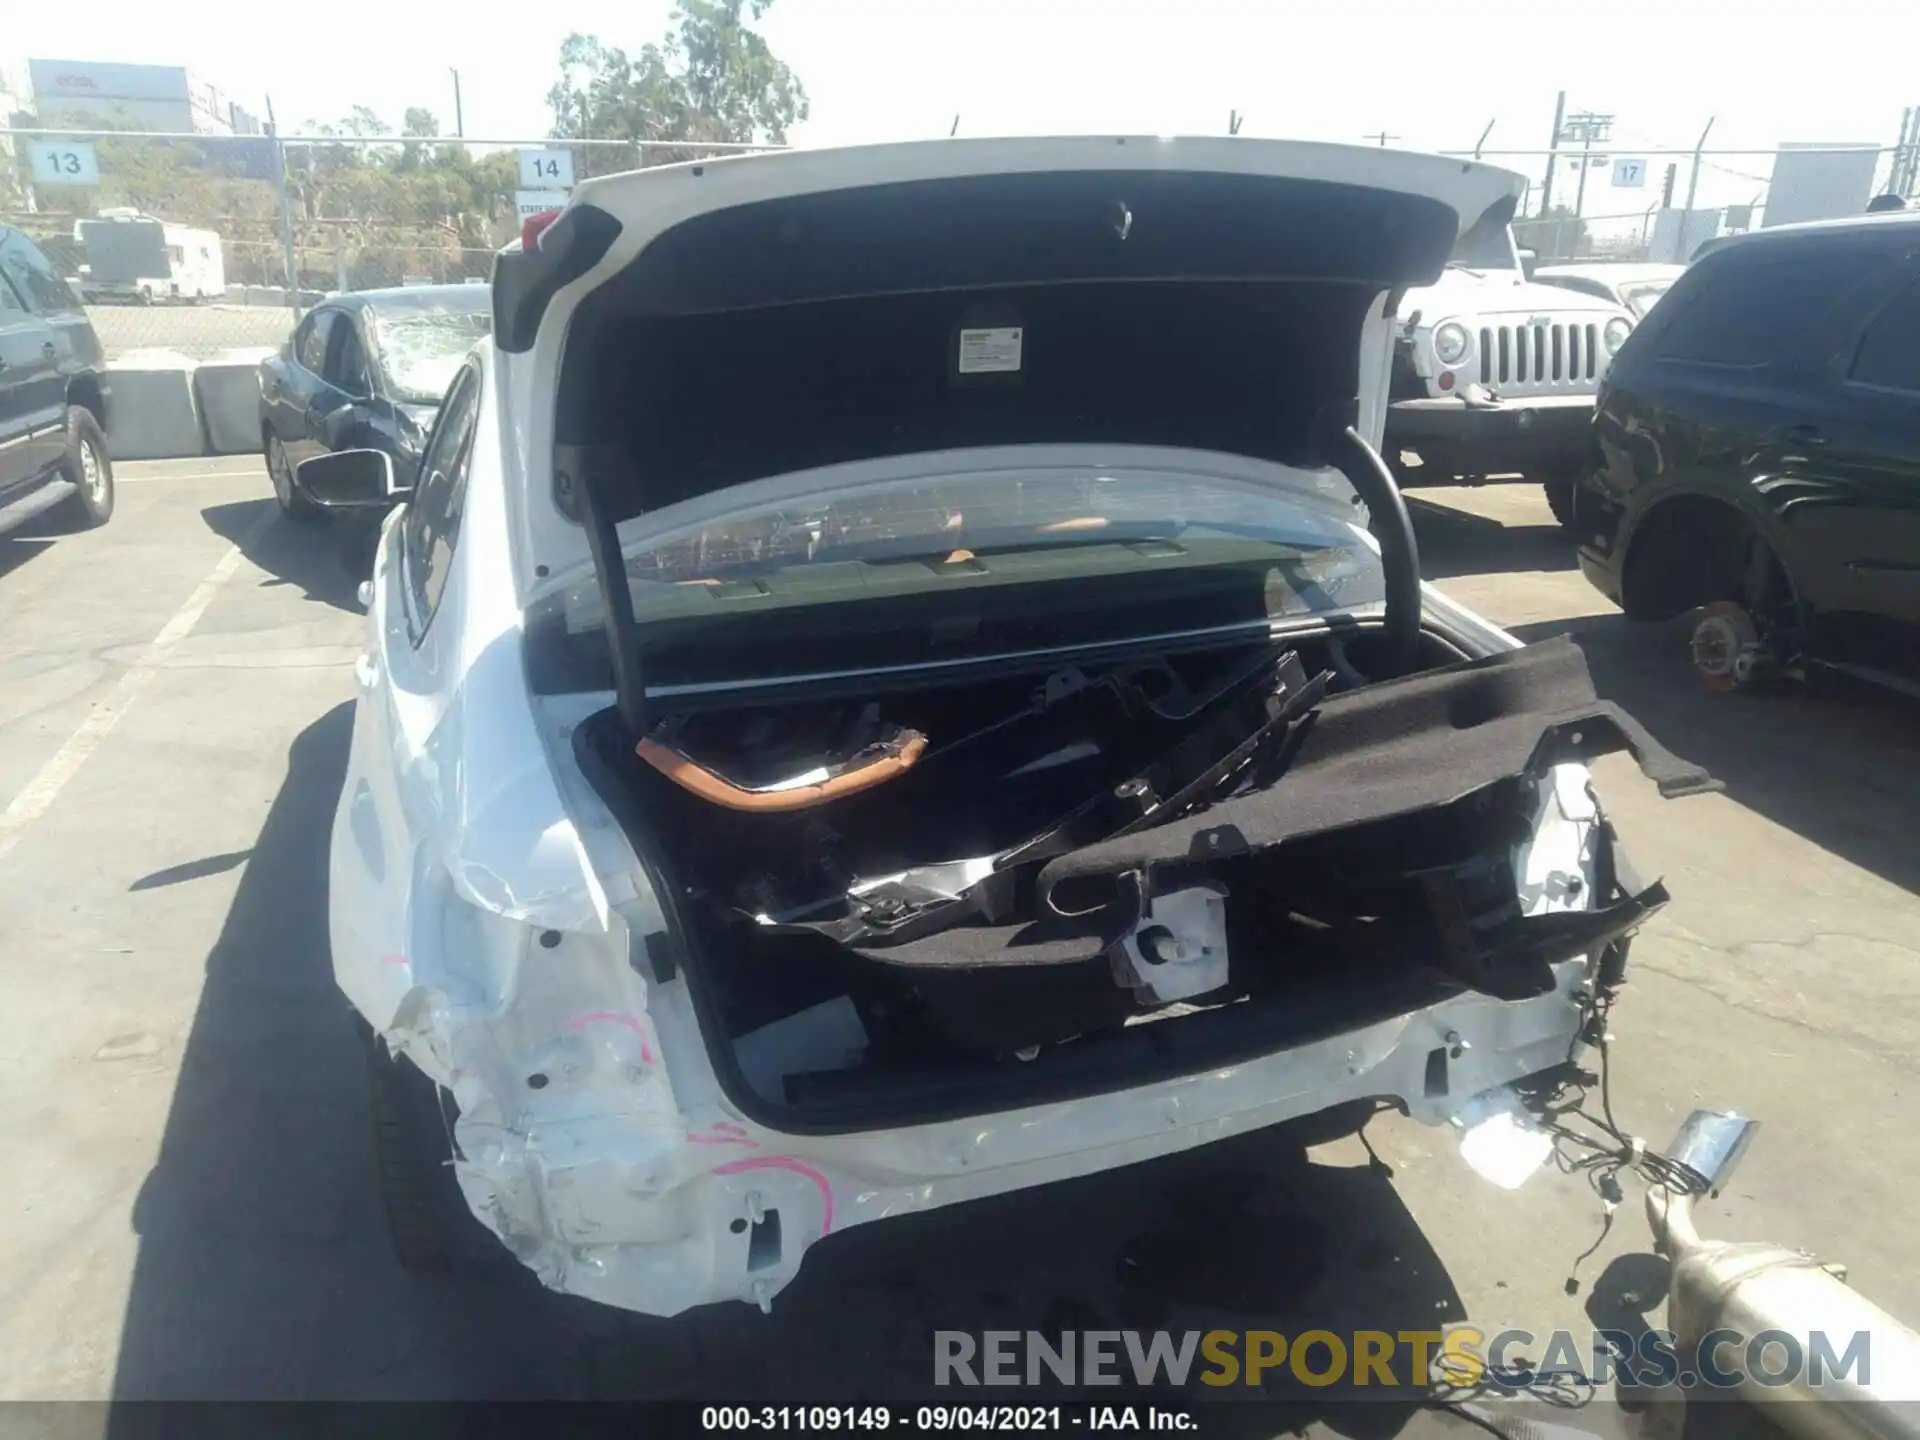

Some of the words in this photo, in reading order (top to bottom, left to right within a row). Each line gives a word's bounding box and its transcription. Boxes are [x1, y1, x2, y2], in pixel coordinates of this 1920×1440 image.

[47, 152, 81, 174] 13
[533, 159, 560, 178] 14
[1620, 164, 1638, 181] 17
